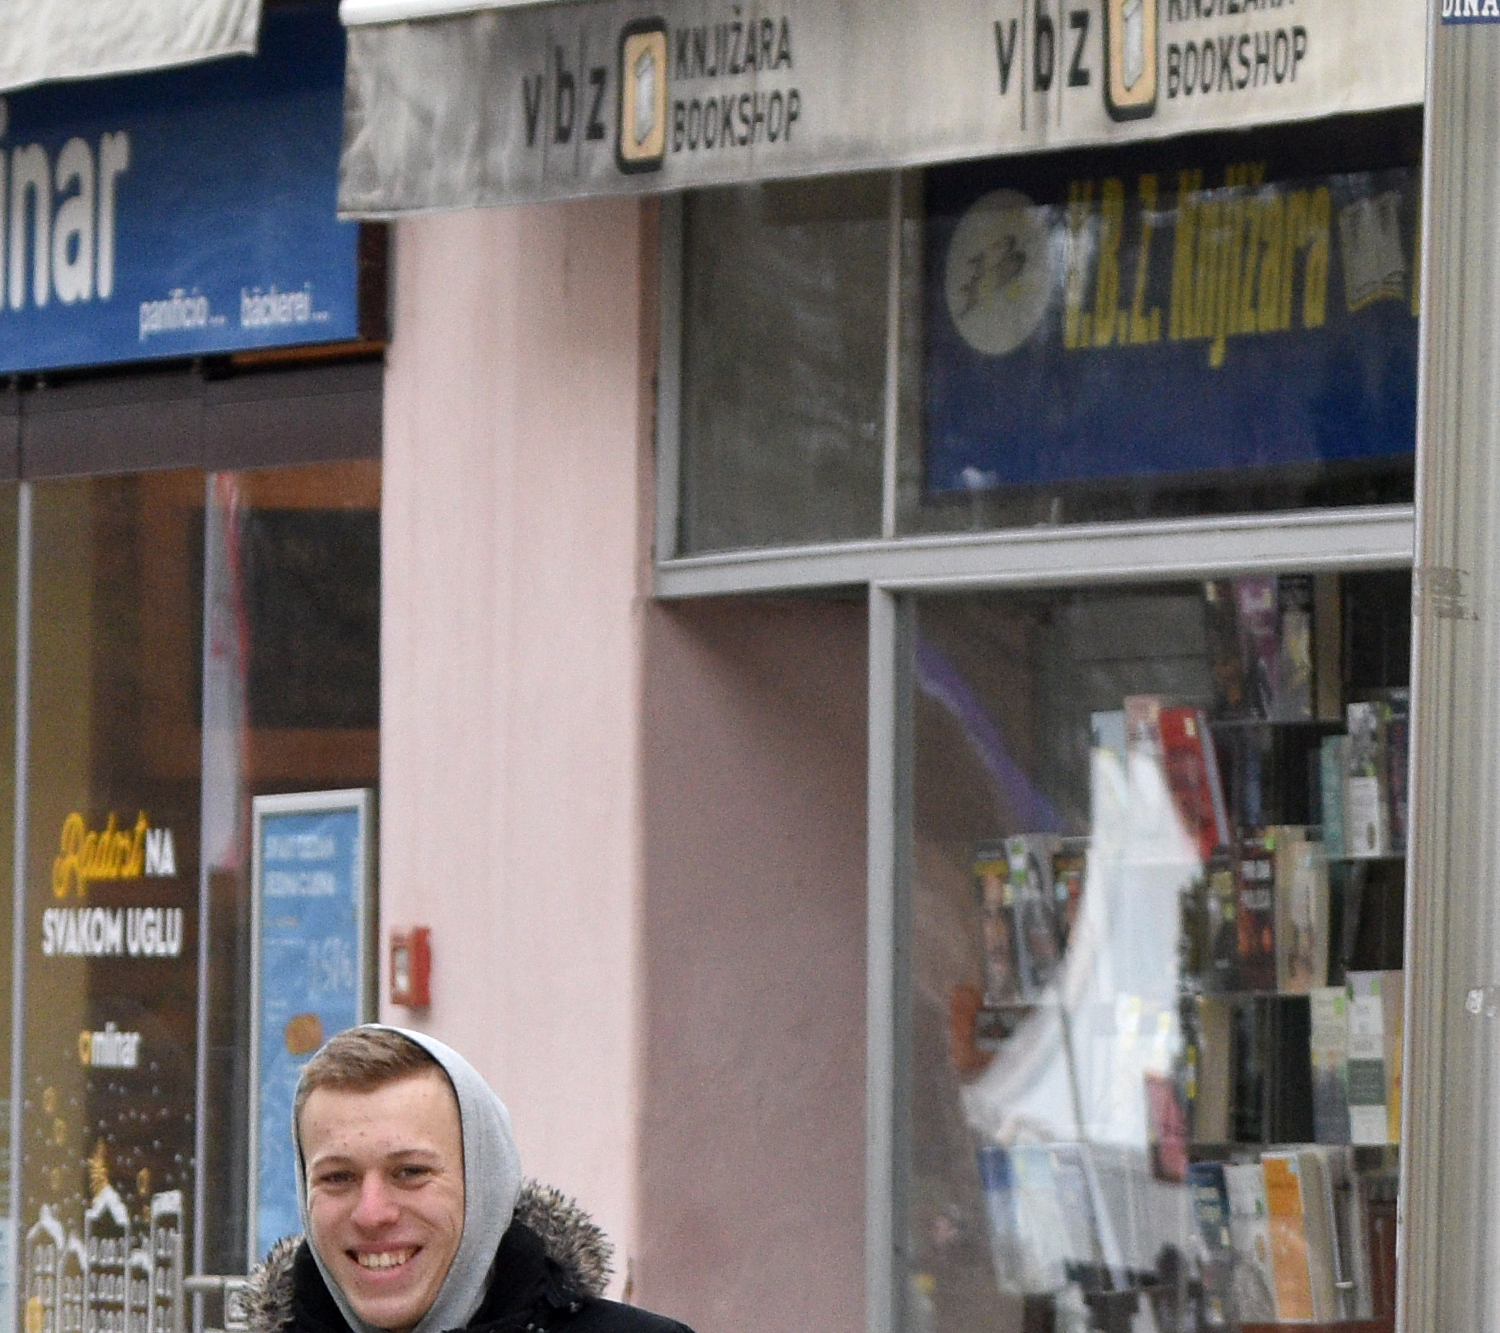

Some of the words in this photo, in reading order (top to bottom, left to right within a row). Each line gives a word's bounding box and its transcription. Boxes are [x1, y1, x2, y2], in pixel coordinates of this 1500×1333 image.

[674, 5, 794, 80] KNJIŽARA
[1167, 25, 1308, 99] BOOKSHOP
[672, 88, 800, 152] BOOKSHOP
[145, 827, 177, 877] NA
[42, 906, 123, 957] SVAKOM
[126, 906, 182, 957] UGLU
[91, 1021, 141, 1068] mlinar
